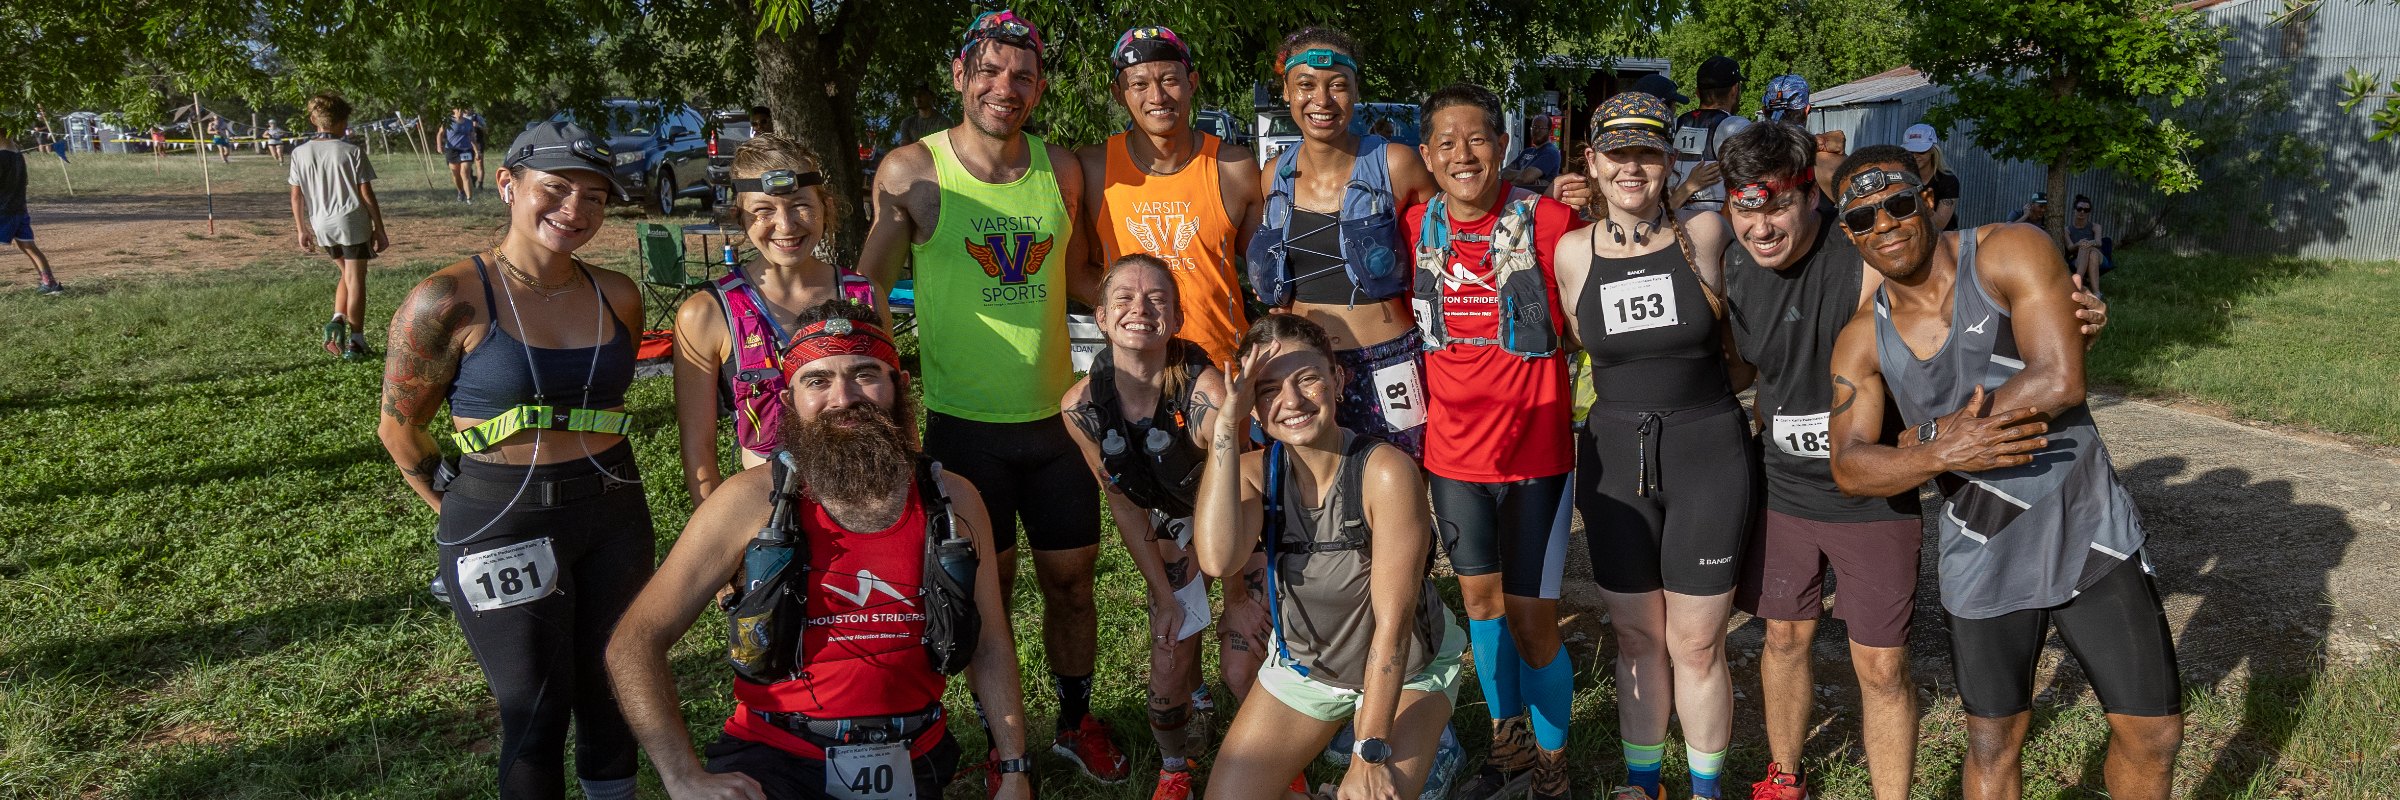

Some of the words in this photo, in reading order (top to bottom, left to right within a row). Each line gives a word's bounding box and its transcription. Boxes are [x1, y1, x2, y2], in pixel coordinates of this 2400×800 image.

[1681, 135, 1696, 149] 11
[1131, 201, 1192, 214] VARSITY
[970, 215, 1043, 233] VARSITY
[1142, 213, 1185, 259] V
[983, 231, 1037, 286] V
[1164, 257, 1196, 271] RTS
[982, 283, 1047, 303] SPORTS
[1462, 296, 1499, 304] STRIDER
[1613, 293, 1665, 324] 153
[1385, 381, 1412, 410] 87
[1785, 430, 1830, 452] 183
[1706, 555, 1733, 565] BANDIT
[475, 560, 542, 600] 181
[808, 614, 868, 626] HOUSTON
[871, 613, 926, 623] STRIDERS
[854, 633, 880, 641] Houston
[851, 764, 894, 795] 40
